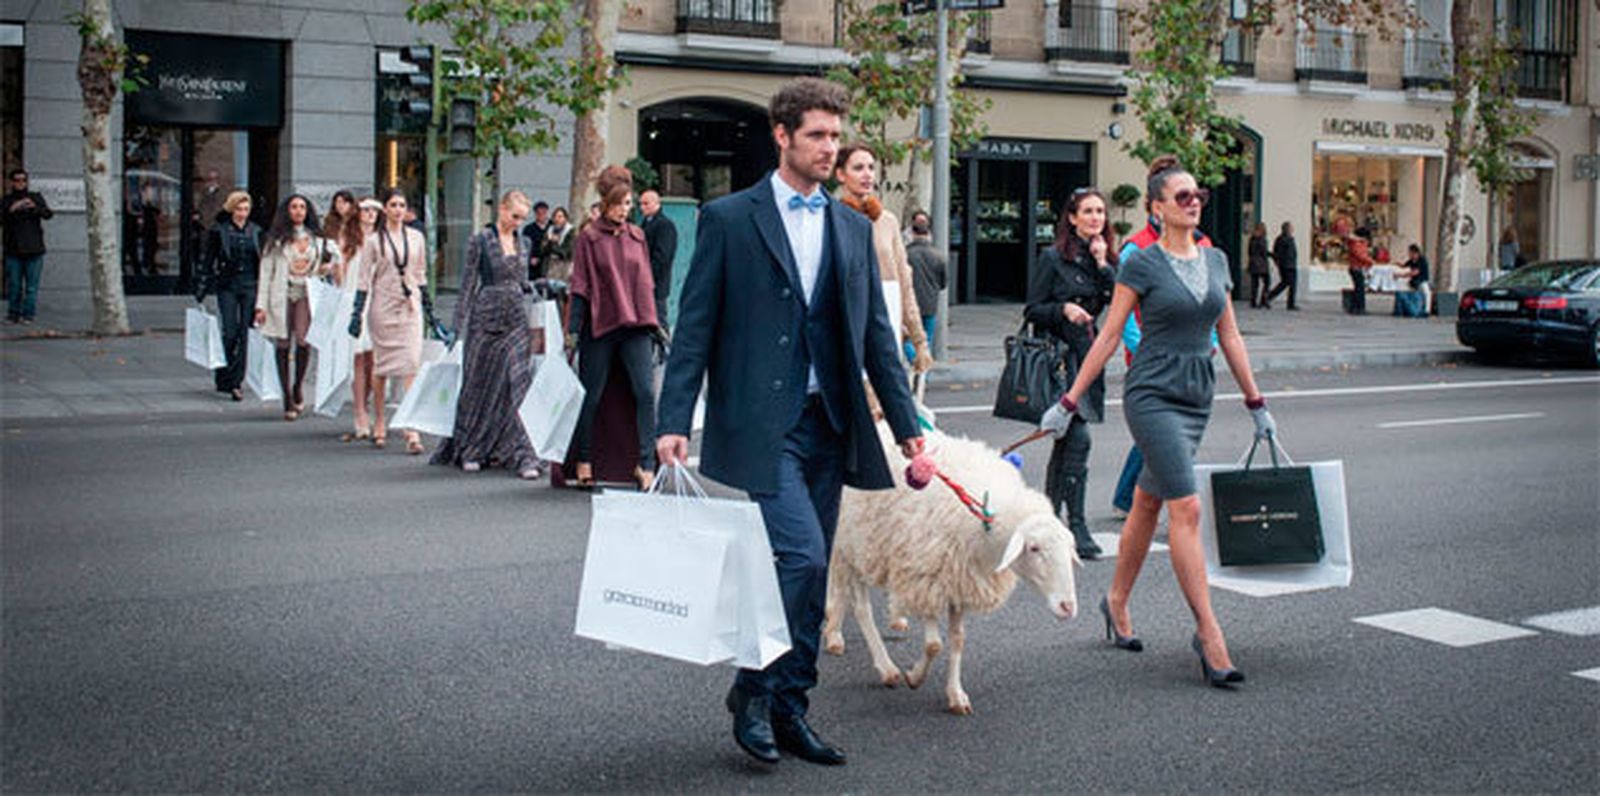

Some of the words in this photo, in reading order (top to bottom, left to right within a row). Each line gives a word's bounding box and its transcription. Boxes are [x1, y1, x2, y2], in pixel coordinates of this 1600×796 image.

[1321, 118, 1389, 138] MICHAEL
[1393, 123, 1435, 141] KORS
[979, 141, 1031, 155] RABAT
